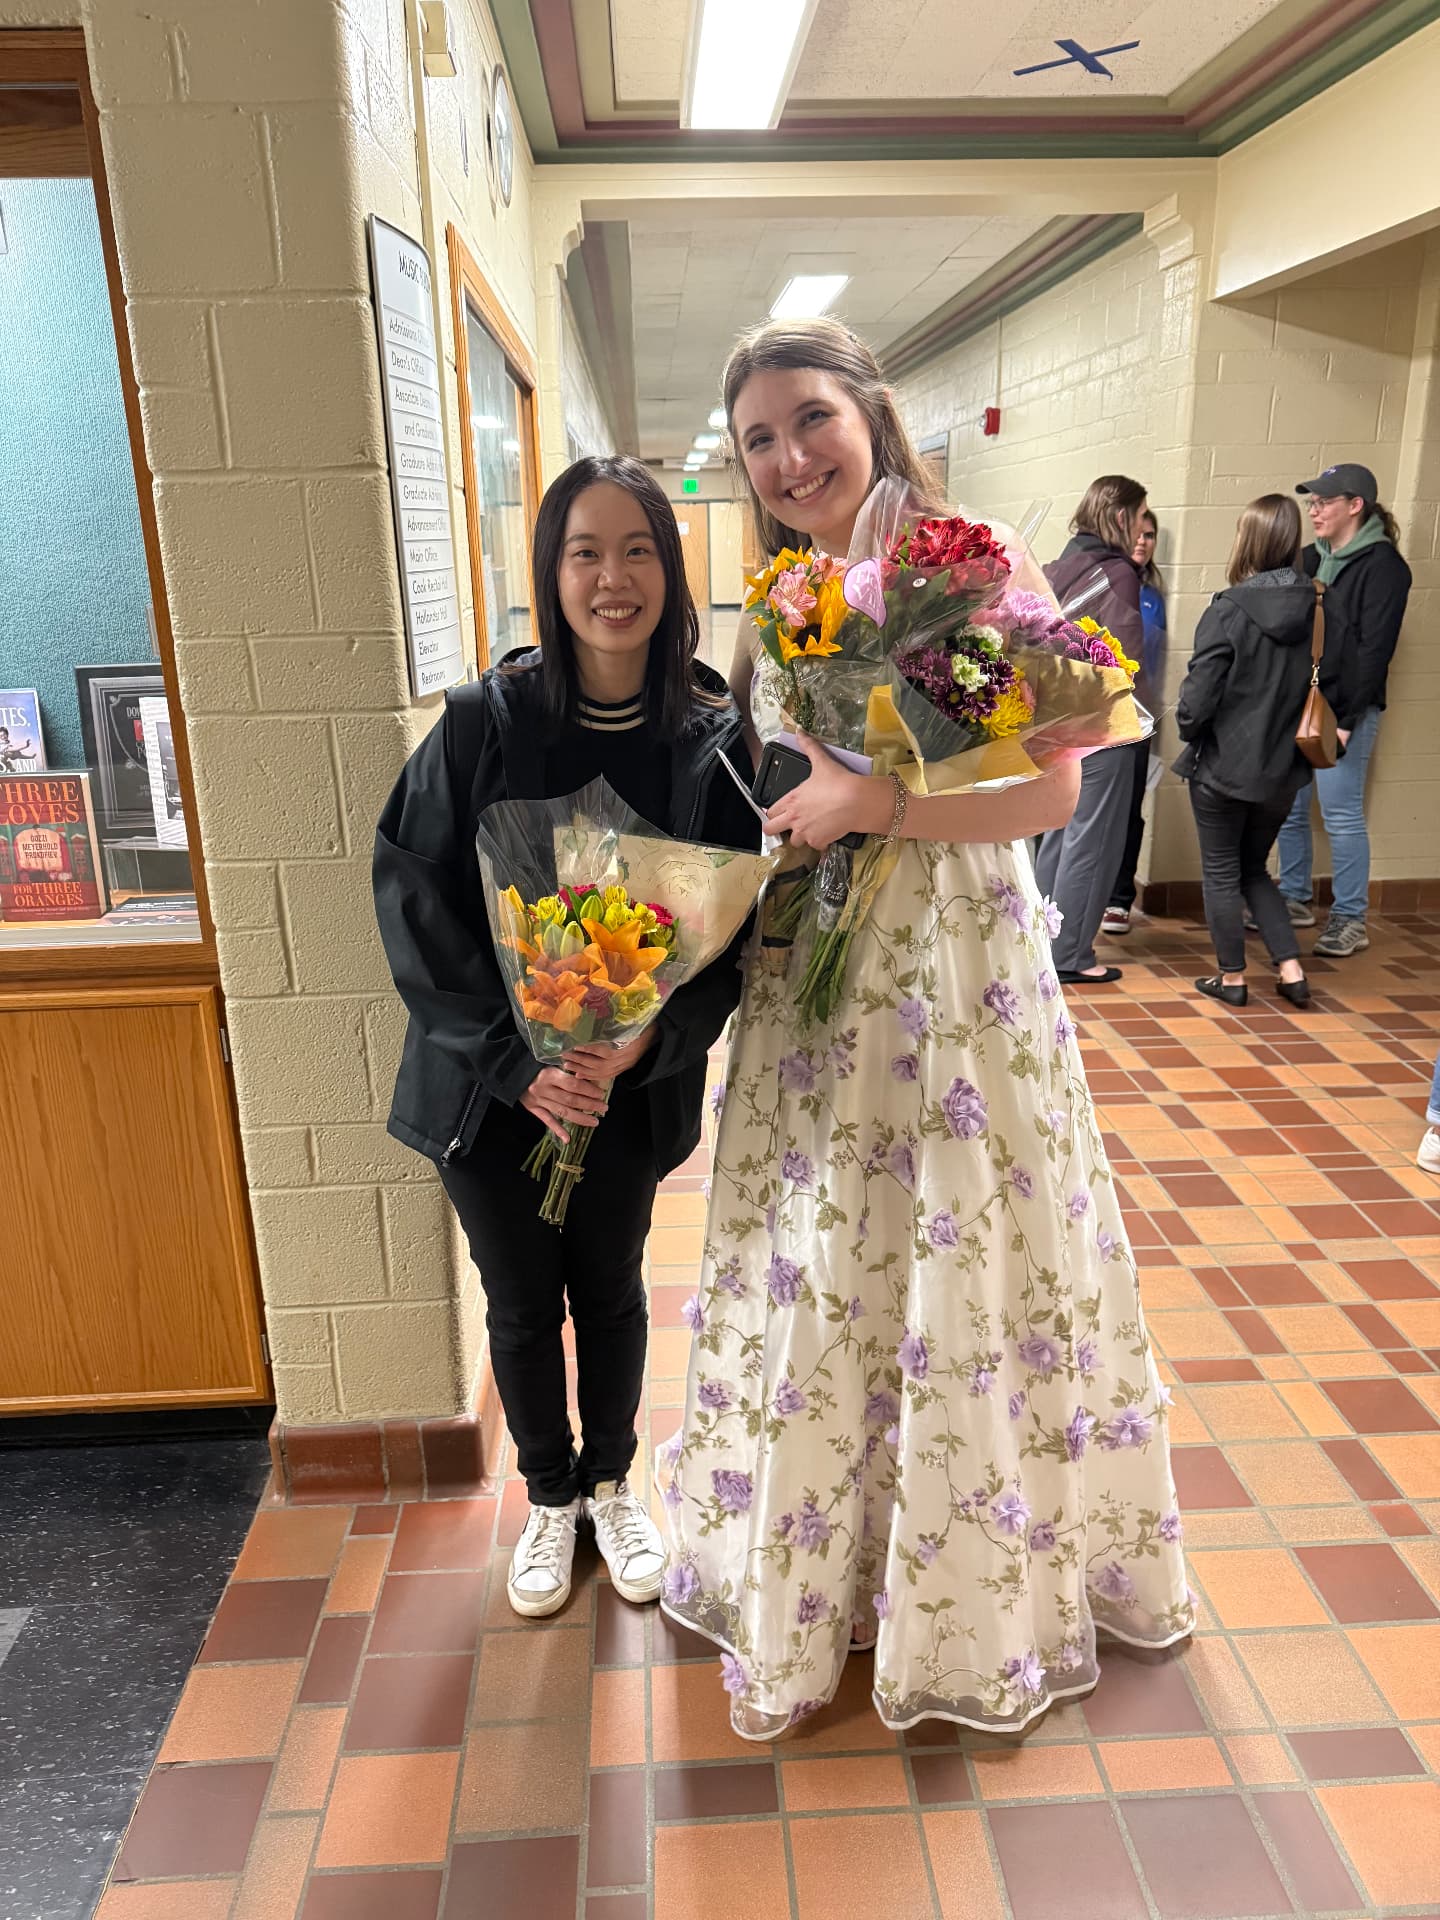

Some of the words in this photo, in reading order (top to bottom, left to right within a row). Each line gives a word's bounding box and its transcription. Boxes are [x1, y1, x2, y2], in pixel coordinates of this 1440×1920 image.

[391, 351, 410, 371] Dean's
[403, 484, 428, 501] Graduate
[409, 548, 424, 565] Main
[412, 577, 427, 594] Cook
[0, 781, 80, 804] HREE
[13, 884, 32, 895] FOR
[31, 881, 82, 895] THREE
[15, 893, 84, 907] ORANGES
